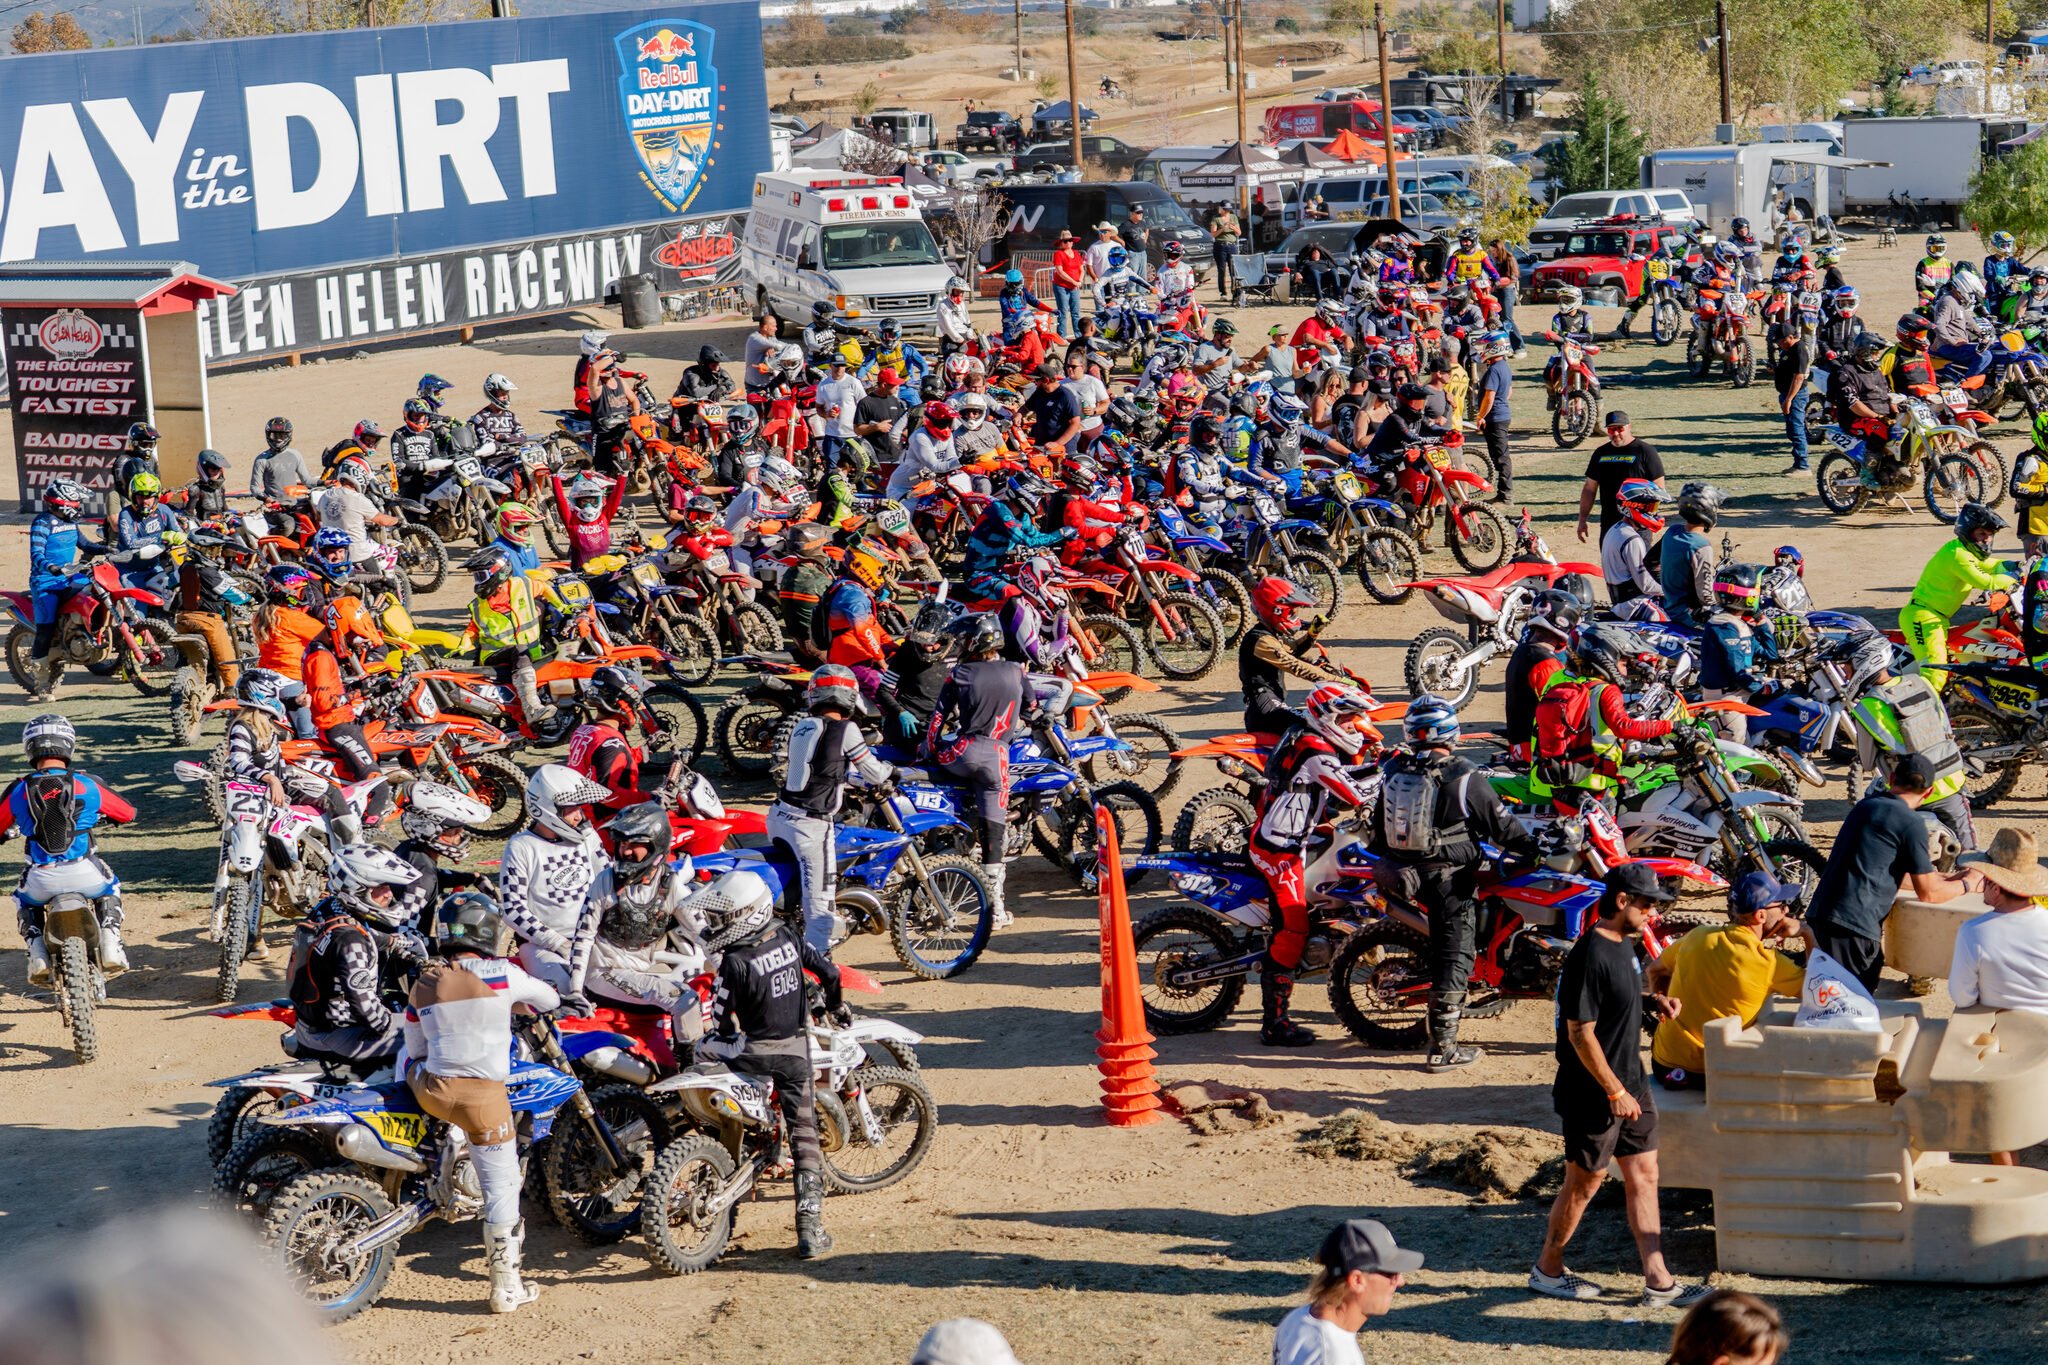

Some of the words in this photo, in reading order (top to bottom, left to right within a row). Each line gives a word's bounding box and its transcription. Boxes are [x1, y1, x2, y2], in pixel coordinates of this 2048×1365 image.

[628, 91, 665, 115] DAY
[669, 87, 711, 112] DIRT
[633, 115, 672, 128] MOTOCROSS
[672, 113, 695, 124] GRAND
[695, 111, 711, 121] PRIX
[1295, 115, 1317, 125] LIQUI
[1295, 125, 1317, 135] MOLY
[244, 58, 571, 232] DIRT
[189, 148, 247, 184] in
[0, 90, 205, 263] AY
[1181, 176, 1208, 185] KEHOE
[1208, 176, 1235, 185] RACING
[1282, 170, 1303, 181] RACING
[182, 178, 252, 209] the
[839, 210, 884, 221] FIREHAWK
[887, 209, 906, 219] EMS
[317, 261, 445, 341] HELEN
[464, 233, 643, 318] RACEWAY
[16, 360, 46, 372] THE
[50, 361, 133, 373] ROUGHEST
[18, 377, 135, 393] TOUGHEST
[20, 397, 136, 415] FASTEST
[703, 407, 722, 416] V23
[24, 432, 130, 449] BADDEST
[1832, 433, 1853, 449] 822
[25, 453, 83, 467] TRACK
[86, 456, 104, 468] IN
[74, 472, 114, 488] LAN
[1622, 500, 1647, 508] 100%
[884, 509, 908, 527] C324
[1650, 632, 1679, 651] 215
[1964, 643, 2020, 659] KTM
[916, 793, 941, 809] 113
[1656, 812, 1700, 832] FASTHOUSE
[381, 1113, 420, 1141] M224
